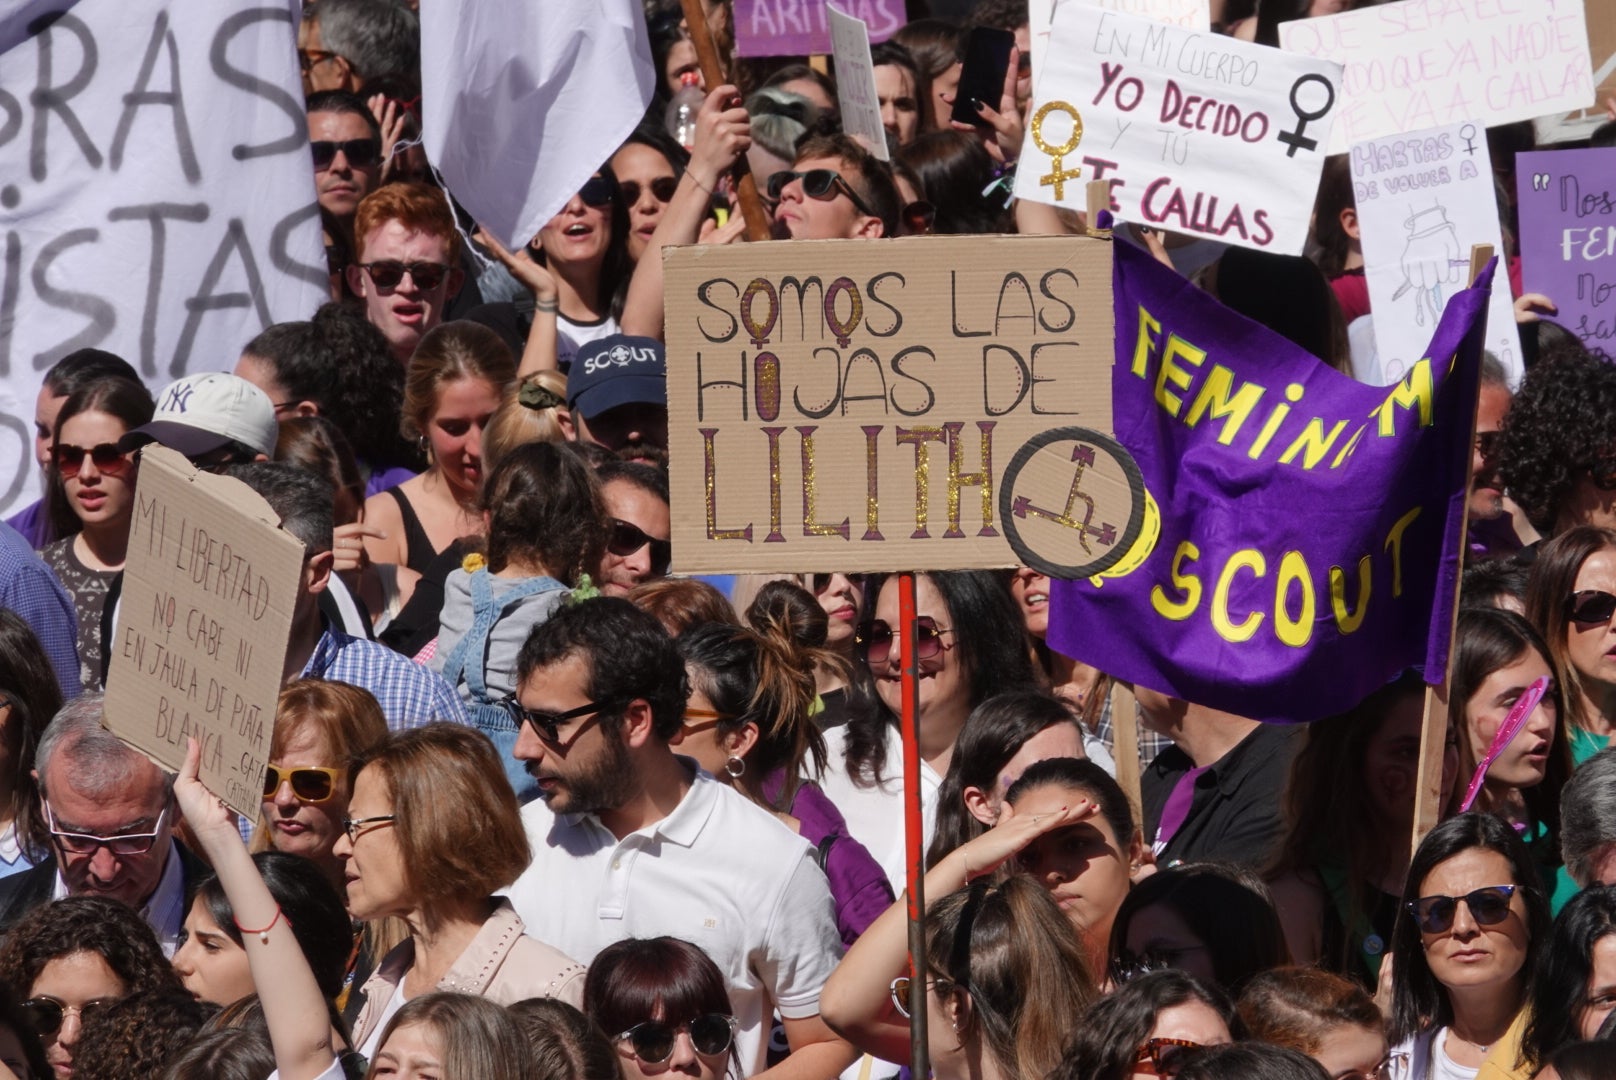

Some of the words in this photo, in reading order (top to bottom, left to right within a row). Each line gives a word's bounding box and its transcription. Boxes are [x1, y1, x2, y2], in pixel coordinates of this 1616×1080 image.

[1093, 12, 1131, 57] EN
[1140, 24, 1170, 68] MI
[1177, 34, 1258, 87] CUERPO
[1286, 15, 1361, 56] QUE
[0, 8, 309, 182] RAS
[1092, 62, 1144, 112] YO
[1160, 79, 1269, 143] DECIDO
[1486, 52, 1595, 112] CALLAR
[1110, 118, 1132, 150] Y
[1352, 132, 1454, 177] HARTAS
[1141, 177, 1274, 246] CALLAS
[697, 271, 906, 345] SOMOS
[951, 268, 1079, 337] LAS
[697, 344, 936, 421] HIJAS
[983, 342, 1079, 416] DE
[698, 421, 999, 544] LILITH
[135, 490, 166, 558] MI
[176, 517, 269, 621] LIBERTAD
[1150, 506, 1423, 648] SCOUT
[187, 608, 224, 662] CABE
[235, 638, 253, 680] NI
[123, 627, 146, 672] EN
[149, 642, 197, 703] JAULA
[205, 678, 228, 720] DE
[230, 693, 264, 752] PLATA
[156, 696, 223, 775] BLANCA
